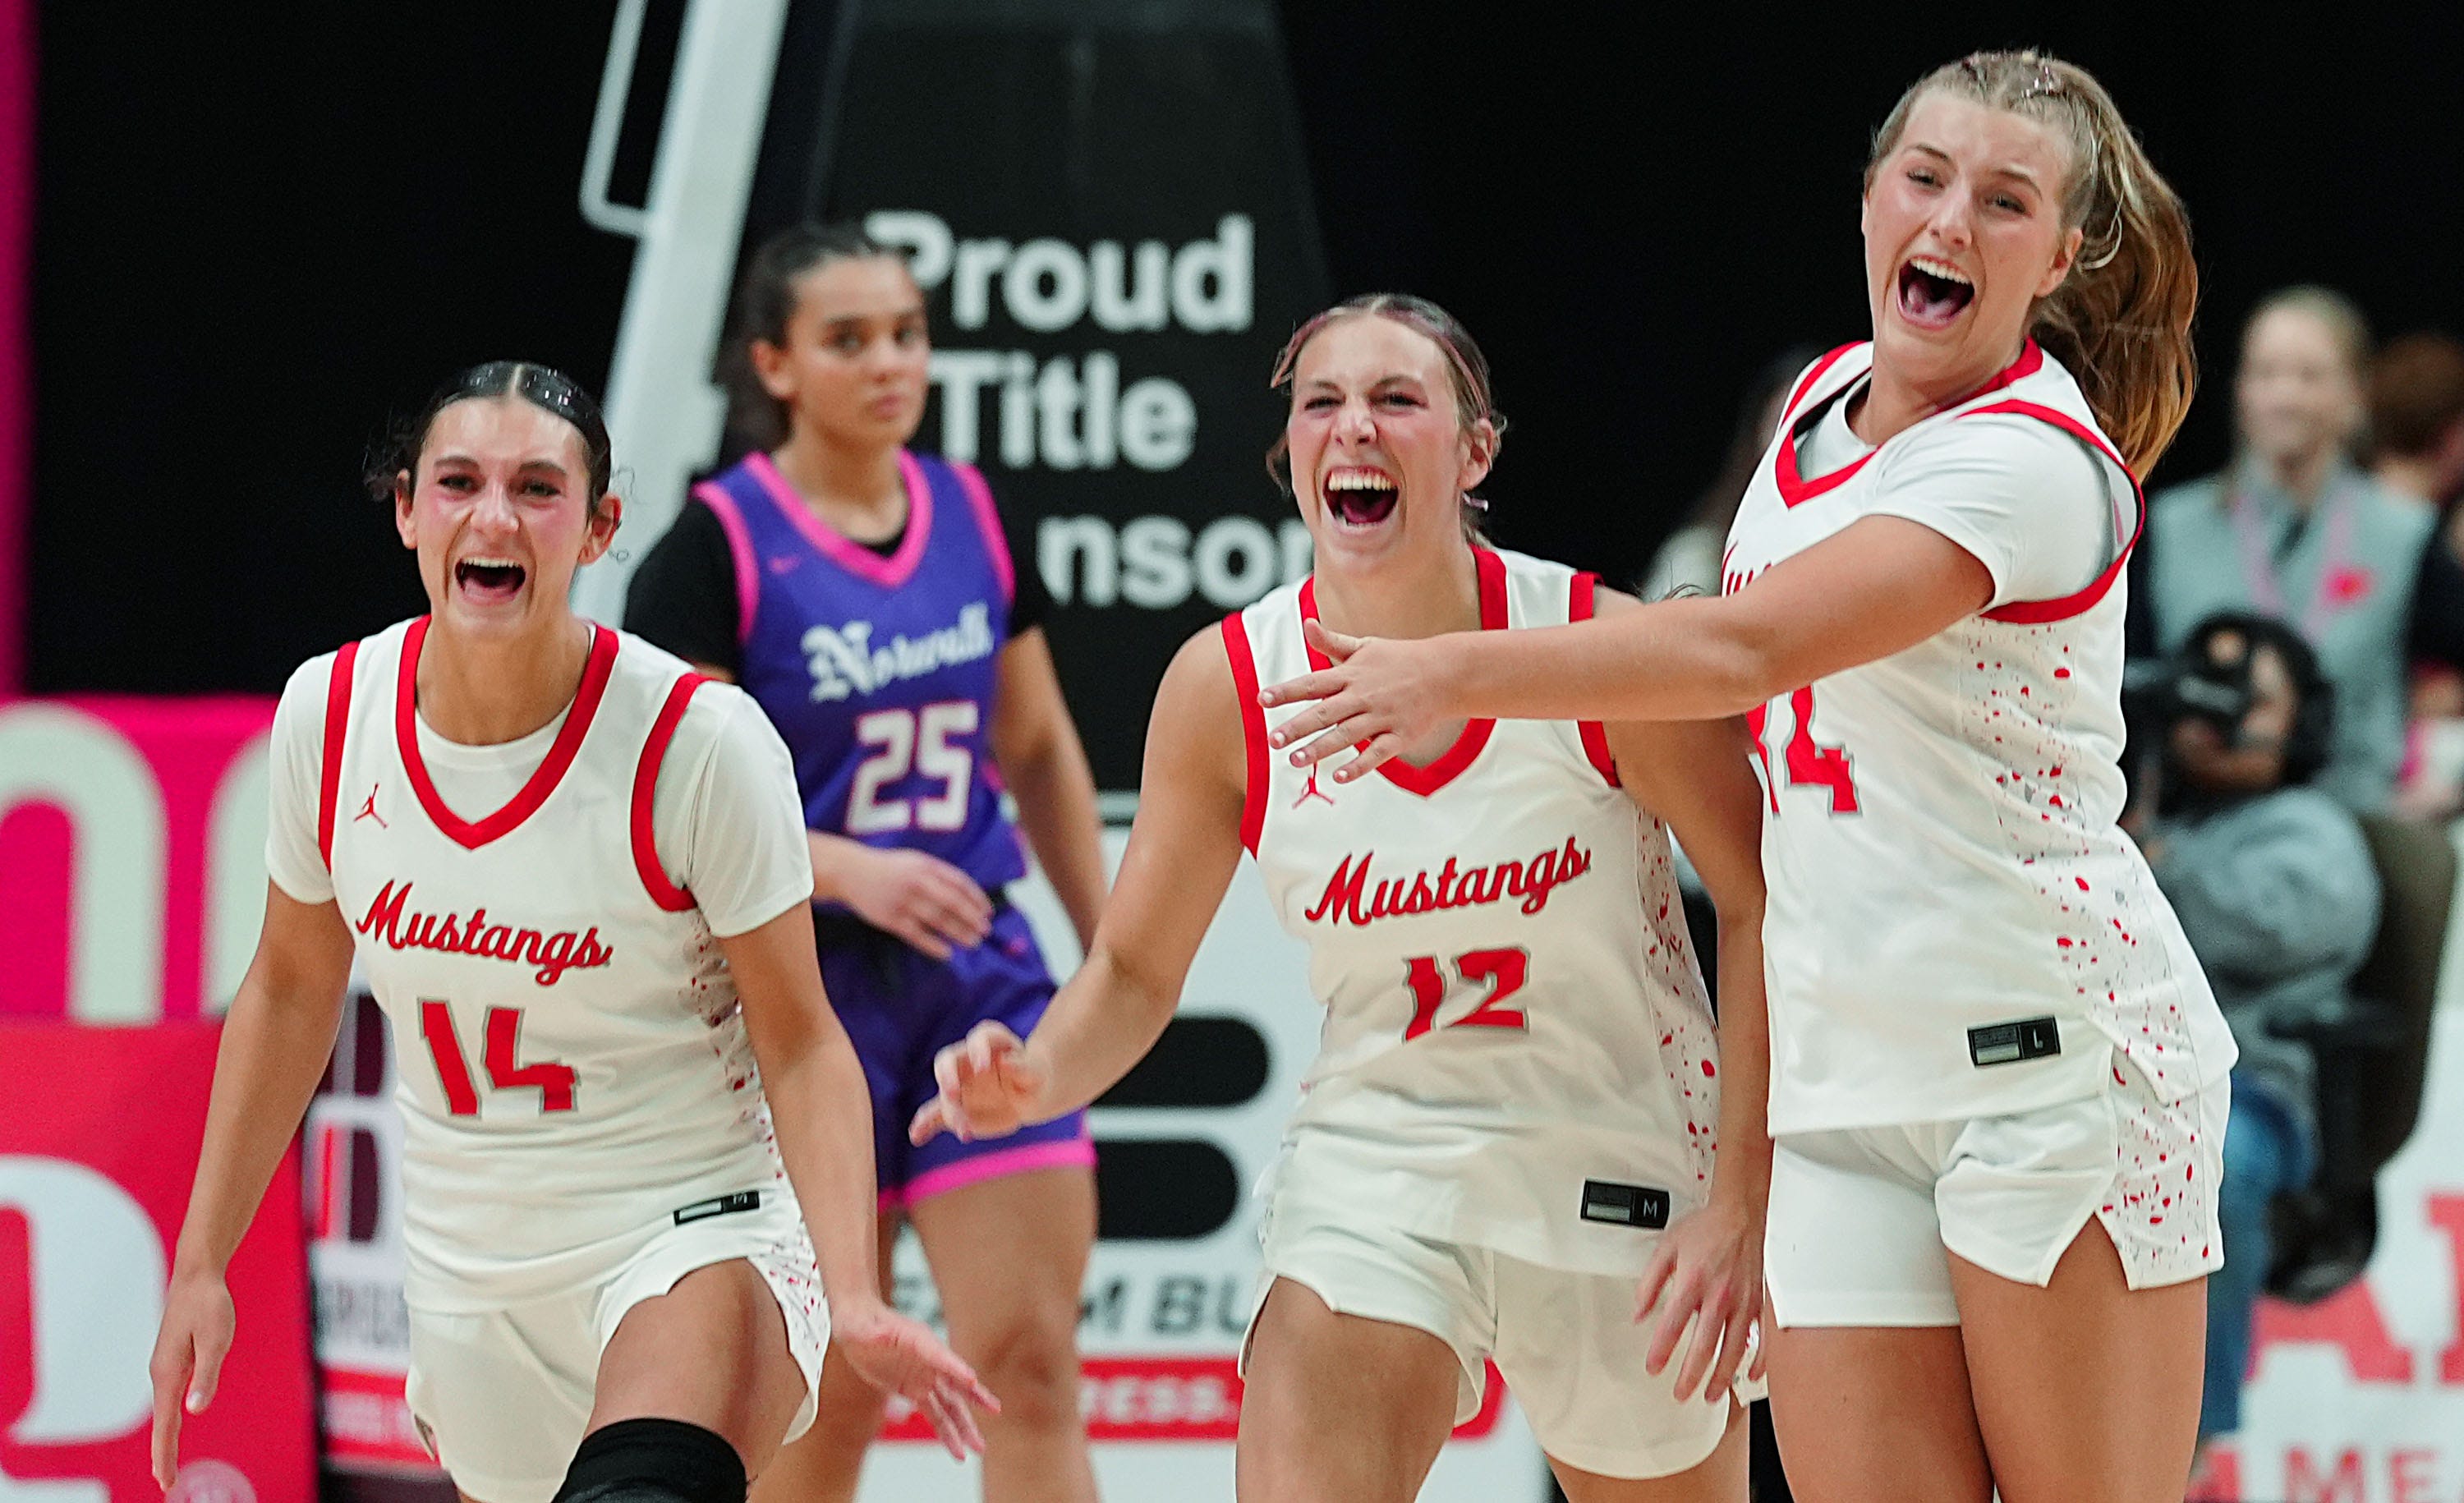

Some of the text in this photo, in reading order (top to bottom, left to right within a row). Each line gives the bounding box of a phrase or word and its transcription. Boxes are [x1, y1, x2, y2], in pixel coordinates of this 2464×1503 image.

[864, 209, 1253, 330] Proud
[928, 350, 1196, 471] Title
[848, 701, 978, 833] 25
[356, 879, 614, 986] Mustangs
[1304, 834, 1592, 926] Mustangs
[1402, 946, 1531, 1044] 12
[2033, 1028, 2043, 1049] L
[417, 997, 582, 1119] 14
[1643, 1197, 1658, 1218] M
